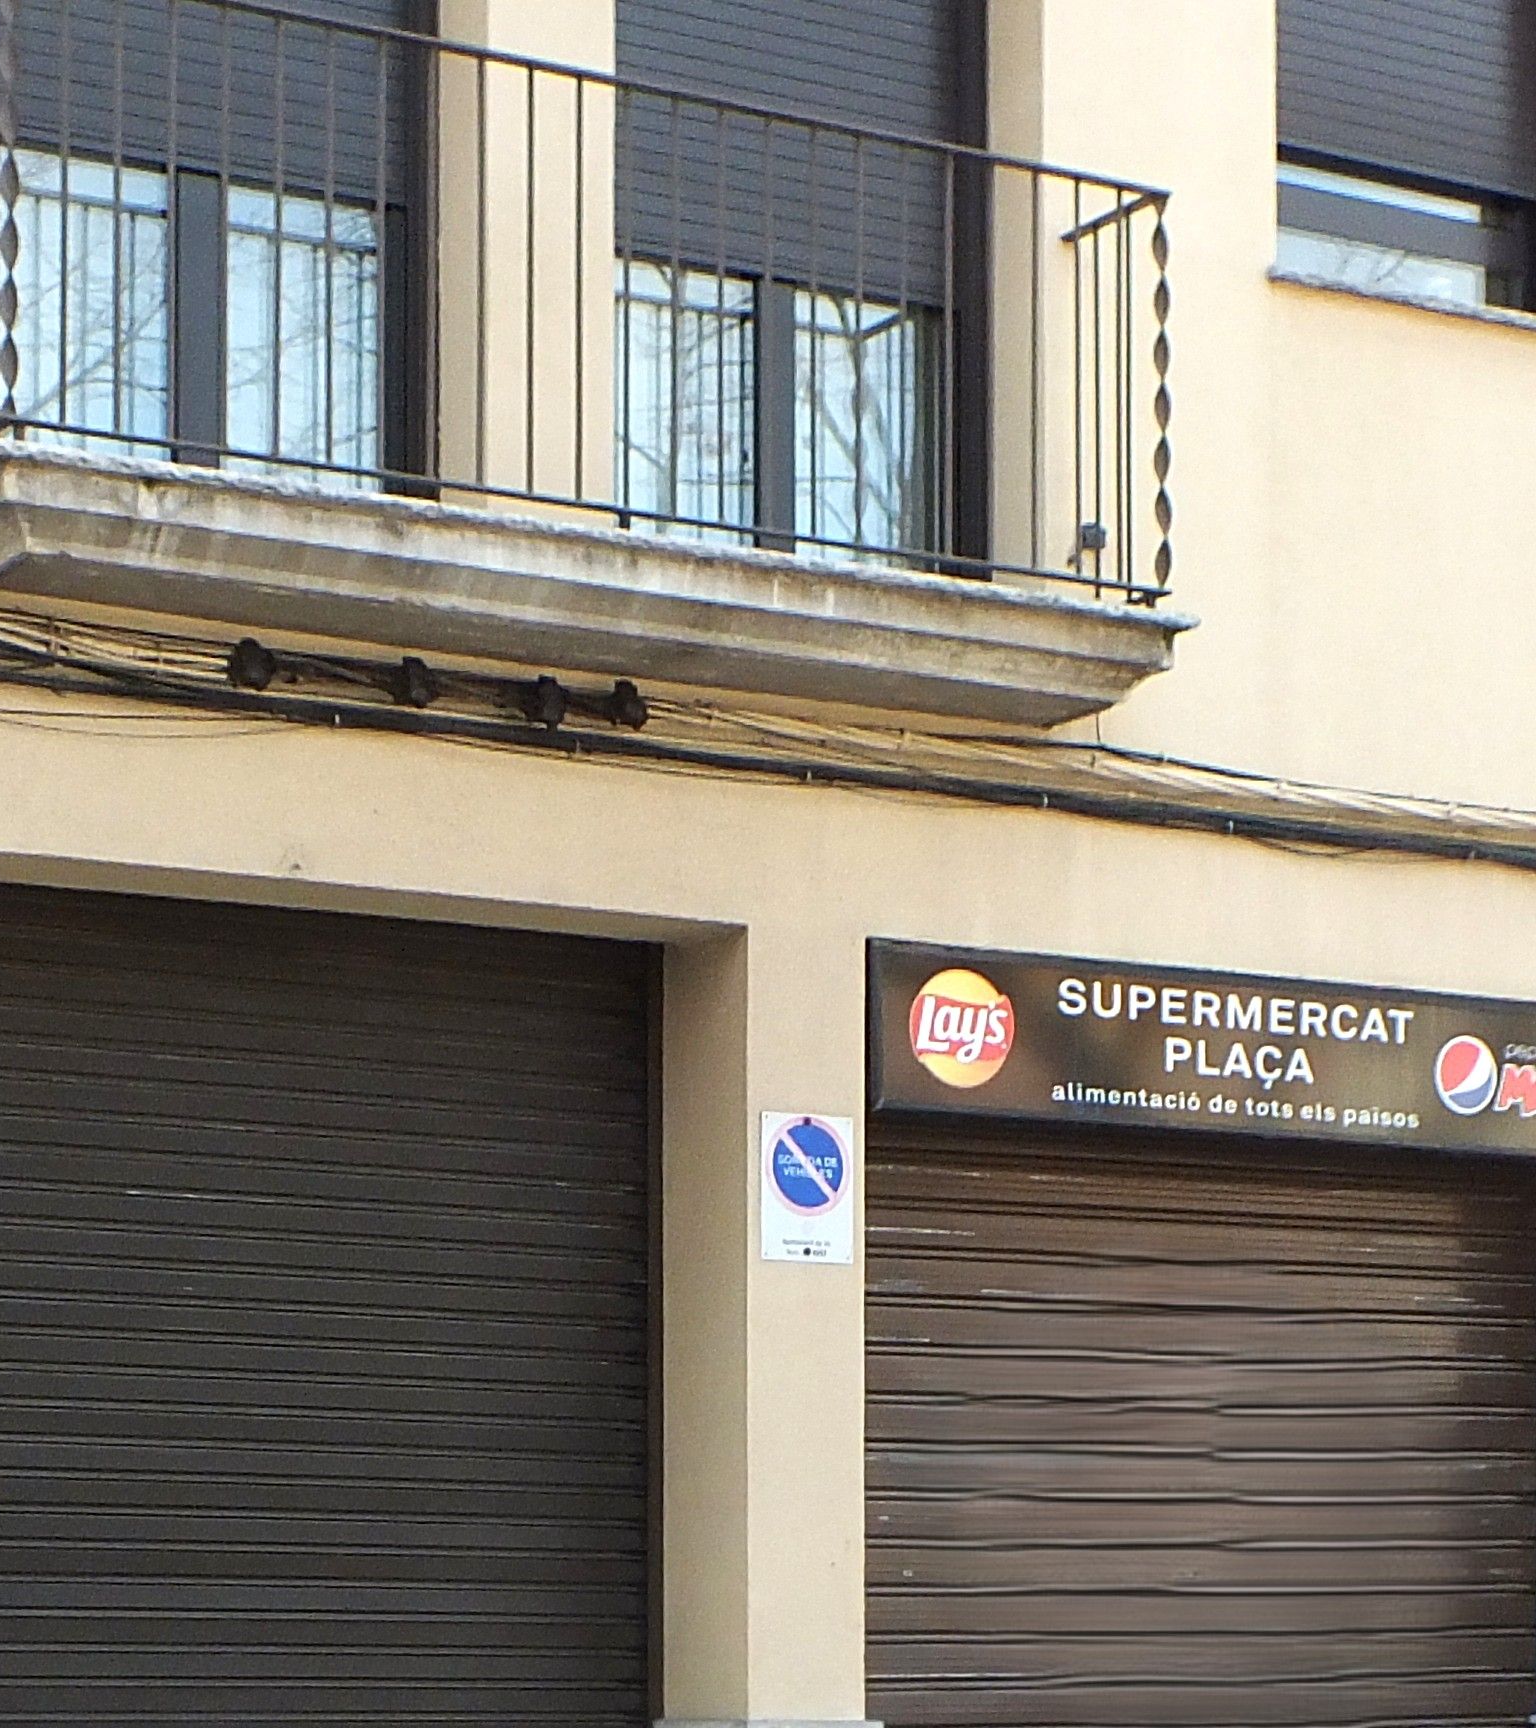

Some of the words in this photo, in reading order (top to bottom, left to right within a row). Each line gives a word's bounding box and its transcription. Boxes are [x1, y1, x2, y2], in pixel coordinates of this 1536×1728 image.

[915, 995, 1009, 1064] Lay's
[1057, 977, 1415, 1045] SUPERMERCAT
[1164, 1036, 1314, 1090] PLAÇA
[1051, 1081, 1201, 1111] alimentació
[1208, 1094, 1238, 1114] de
[1245, 1097, 1294, 1119] tots
[1299, 1102, 1336, 1122] els
